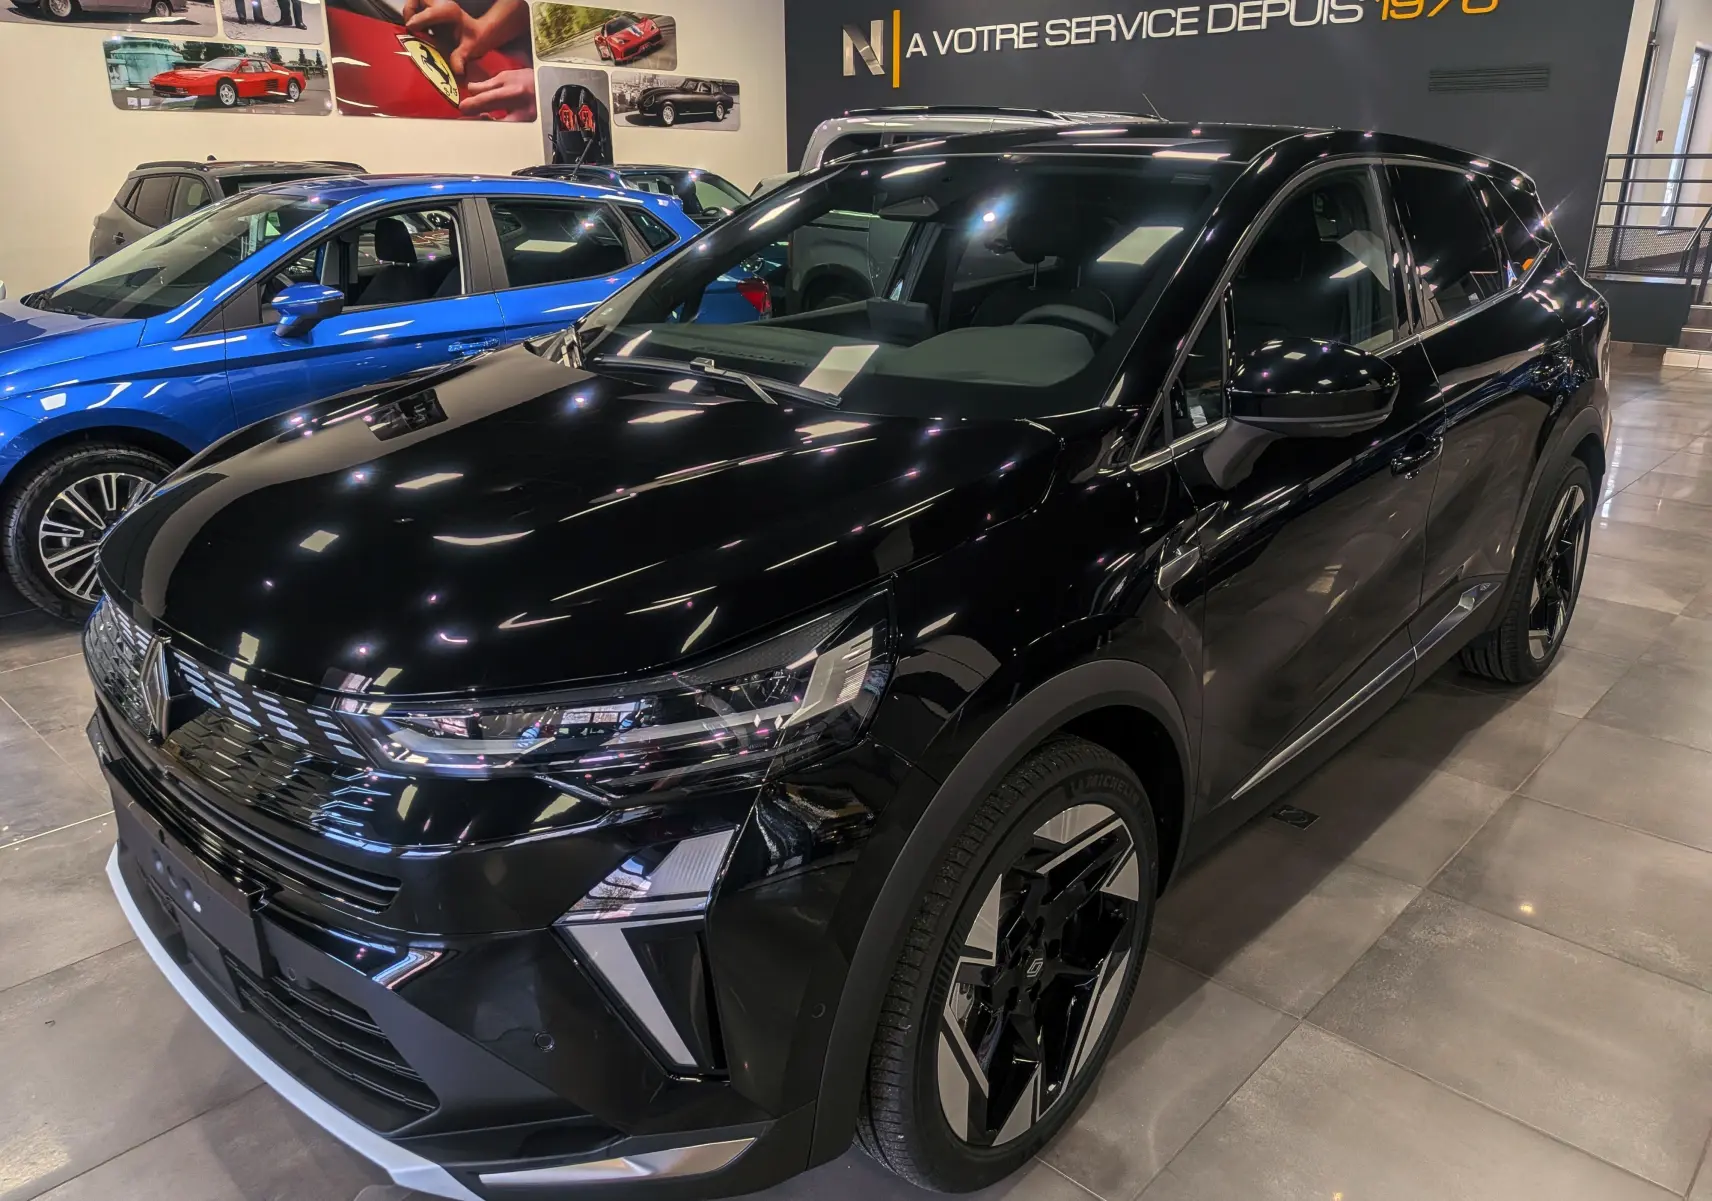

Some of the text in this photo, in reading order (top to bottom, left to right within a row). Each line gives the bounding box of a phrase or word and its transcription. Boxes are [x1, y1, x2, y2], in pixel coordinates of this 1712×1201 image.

[905, 32, 929, 59] A
[932, 21, 1040, 56] VOTRE
[1044, 6, 1201, 48] SERVICE
[1206, 0, 1365, 34] DEPUIS
